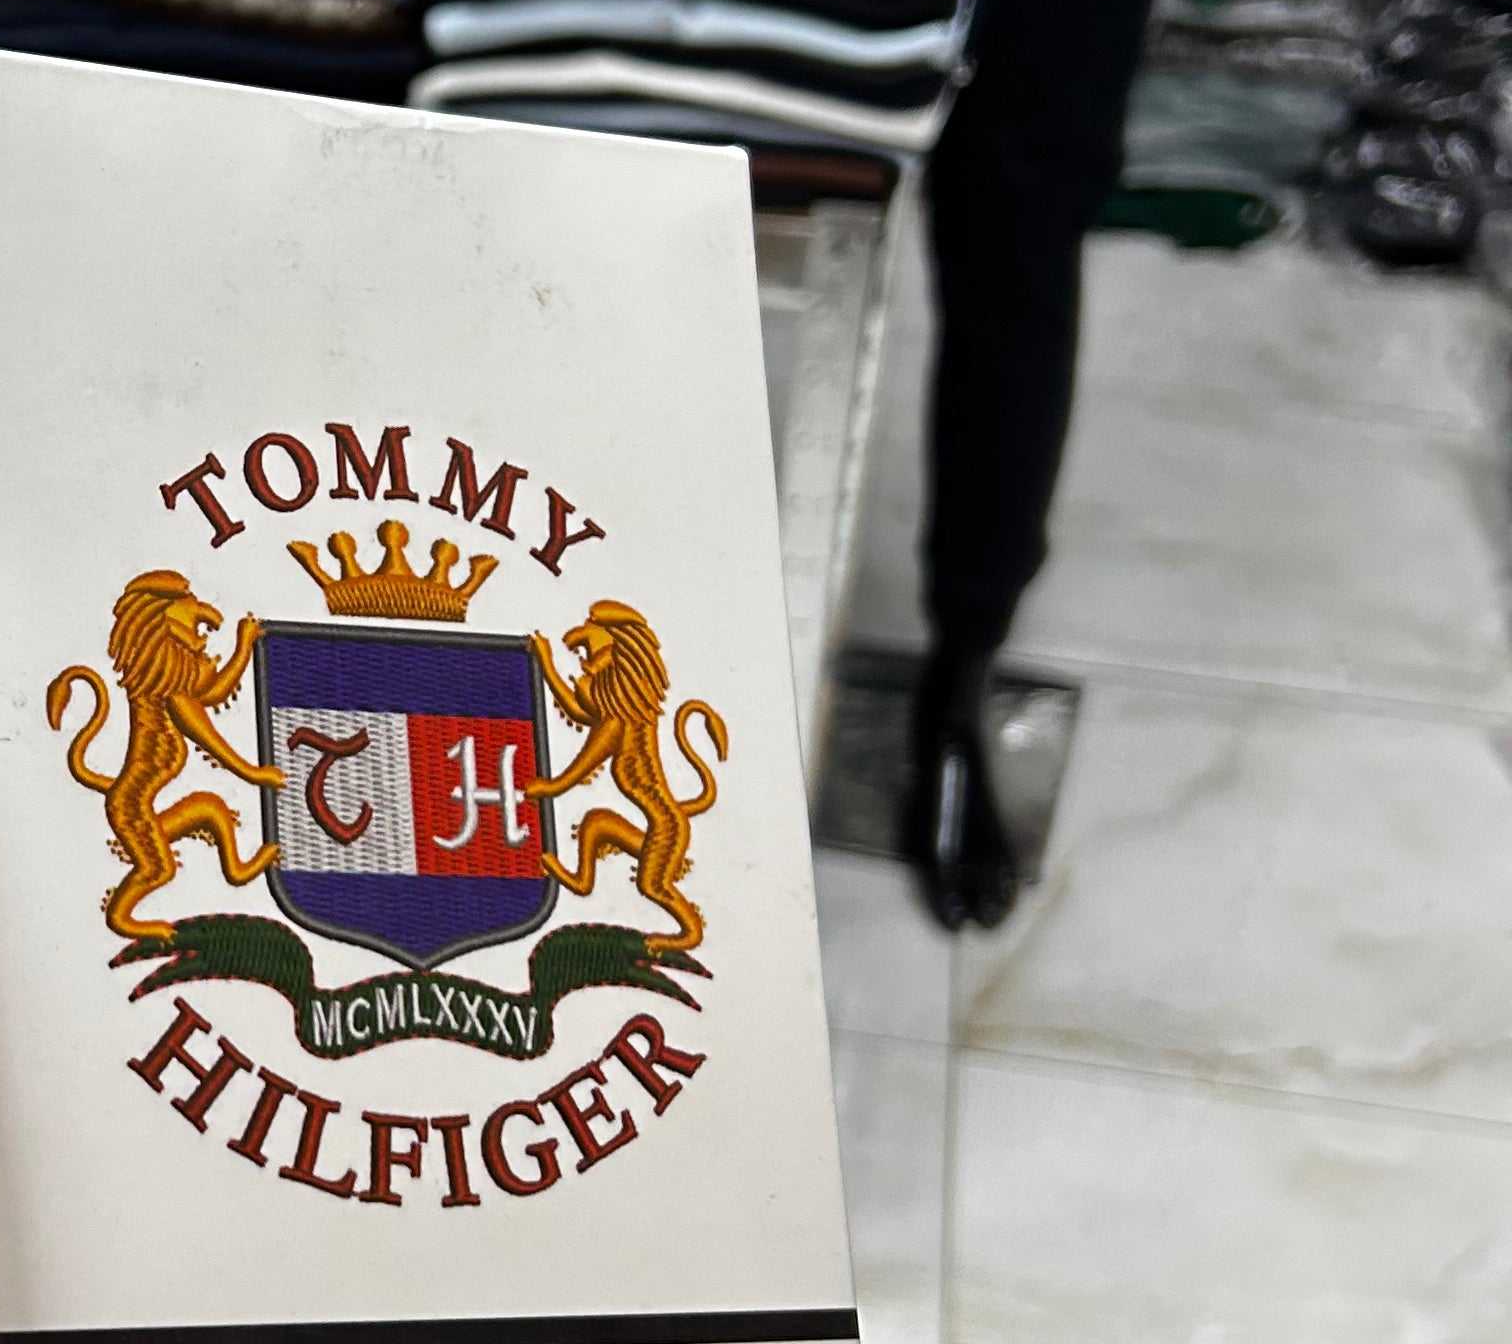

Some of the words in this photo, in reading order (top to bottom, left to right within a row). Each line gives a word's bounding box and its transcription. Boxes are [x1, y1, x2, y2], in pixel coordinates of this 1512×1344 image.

[159, 422, 606, 577] TOMMY
[311, 983, 538, 1051] MCMLXXXV
[127, 997, 707, 1208] HILFIGER
